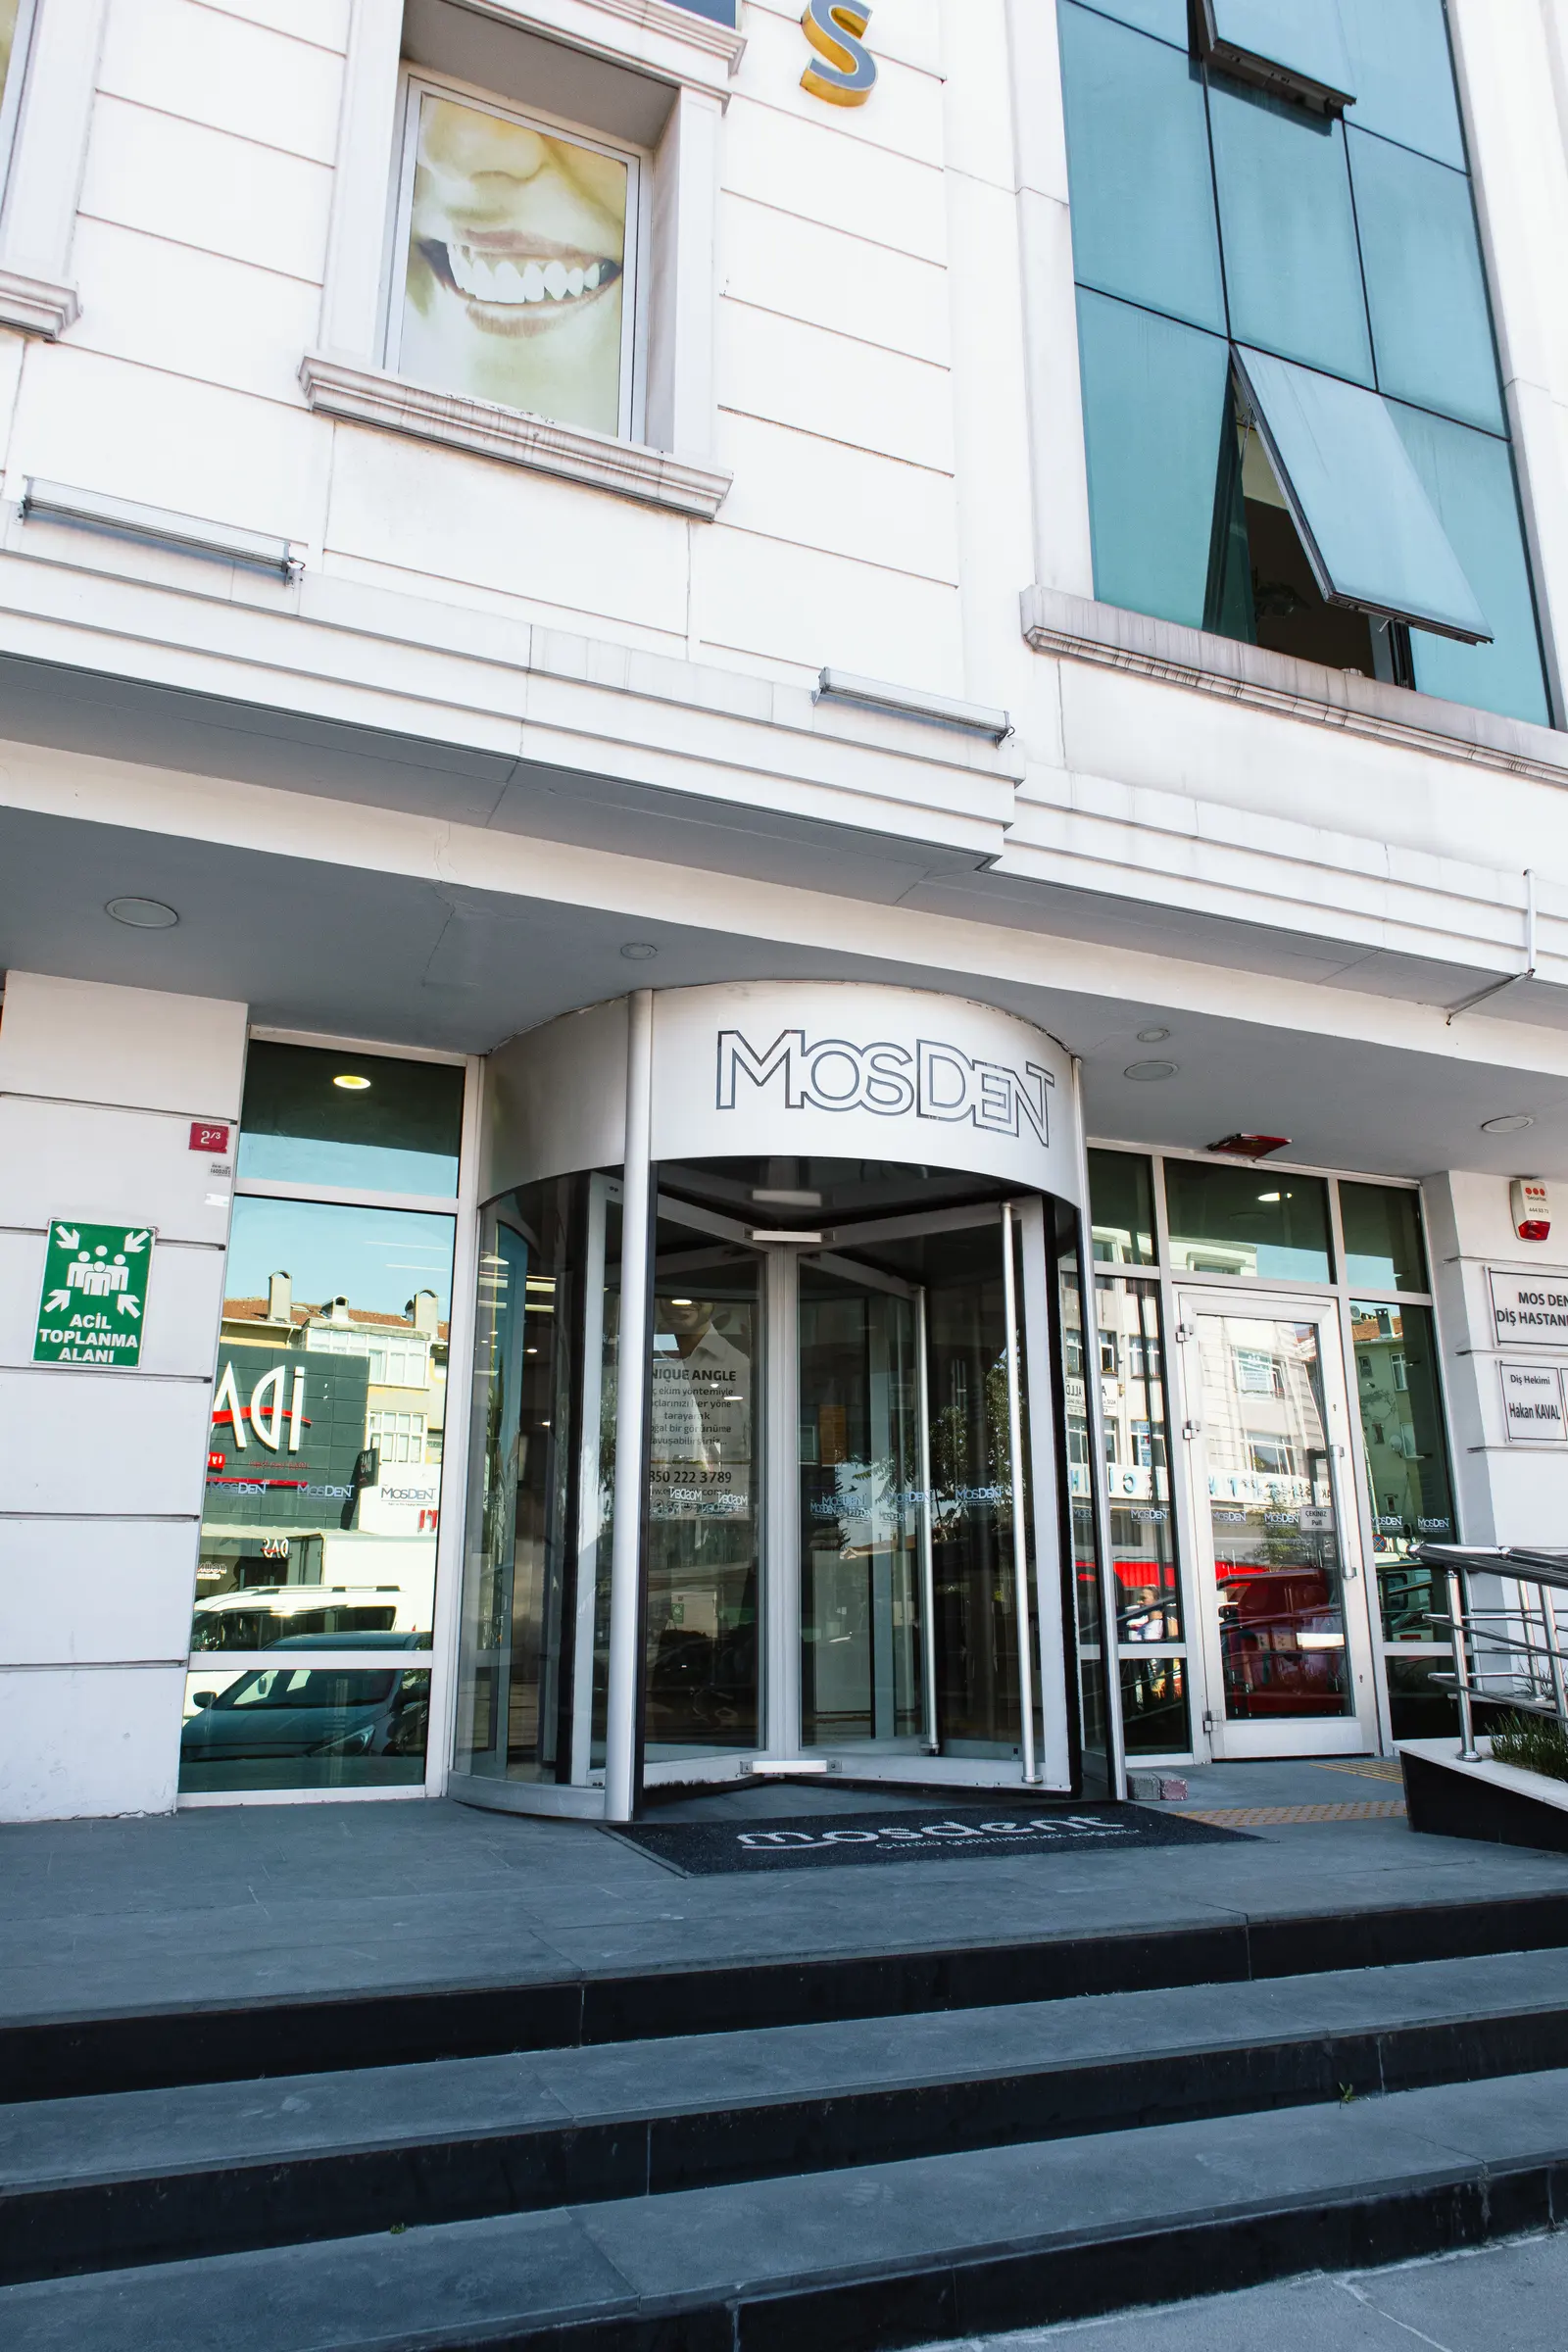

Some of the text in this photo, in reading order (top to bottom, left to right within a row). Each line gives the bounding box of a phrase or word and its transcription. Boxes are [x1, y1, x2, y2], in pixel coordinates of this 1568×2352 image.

[801, 0, 878, 102] S
[716, 1029, 1054, 1148] MOSDENT
[1518, 1292, 1545, 1305] MOS
[70, 1313, 112, 1329] ACİL
[1495, 1308, 1516, 1326] DİŞ
[39, 1328, 138, 1348] TOPLANMA
[58, 1348, 115, 1363] ALANI
[692, 1369, 736, 1381] ANGLE
[1510, 1374, 1550, 1385] Diş Hekimi
[659, 1386, 680, 1396] ekim
[682, 1387, 734, 1397] yöntemiyle
[652, 1398, 689, 1407] clarınızı
[710, 1400, 732, 1409] yöne
[1509, 1402, 1561, 1420] Hakan KAVAL
[669, 1424, 683, 1433] bir
[673, 1471, 696, 1484] 222
[699, 1471, 732, 1484] 3789
[380, 1487, 437, 1500] MOSDENT
[737, 1816, 1125, 1849] mosdent
